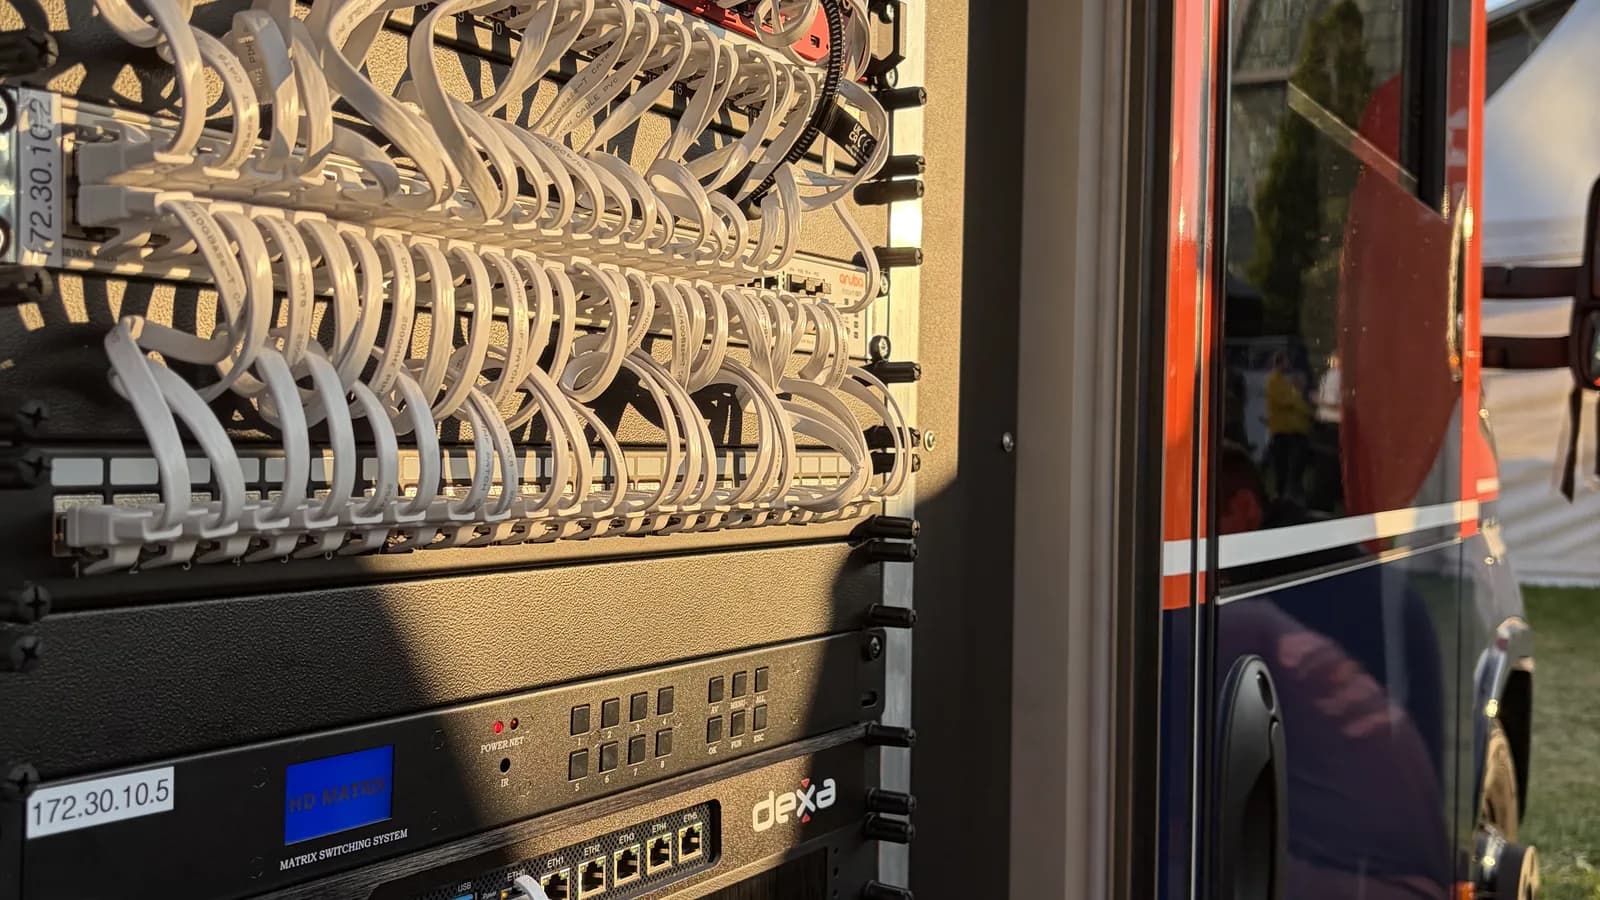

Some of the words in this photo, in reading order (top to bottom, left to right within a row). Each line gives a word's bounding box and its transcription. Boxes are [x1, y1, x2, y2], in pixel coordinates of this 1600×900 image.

[674, 82, 683, 96] 16
[575, 95, 598, 119] CABLE
[839, 273, 864, 288] aruba
[480, 740, 509, 754] POWER
[509, 735, 525, 747] NET
[500, 777, 510, 788] IR
[321, 777, 385, 808] MATRIX
[32, 778, 170, 826] 172.30.10.5
[752, 777, 837, 833] dexa
[683, 811, 698, 823] ETH5
[652, 821, 667, 834] ETH4
[618, 831, 635, 844] ETH3
[279, 851, 318, 871] MATRIX
[318, 838, 372, 861] SWITCHING
[373, 828, 409, 846] SYSTEM
[583, 843, 601, 857] ETH2
[547, 855, 565, 869] ETH1
[457, 881, 472, 892] USB
